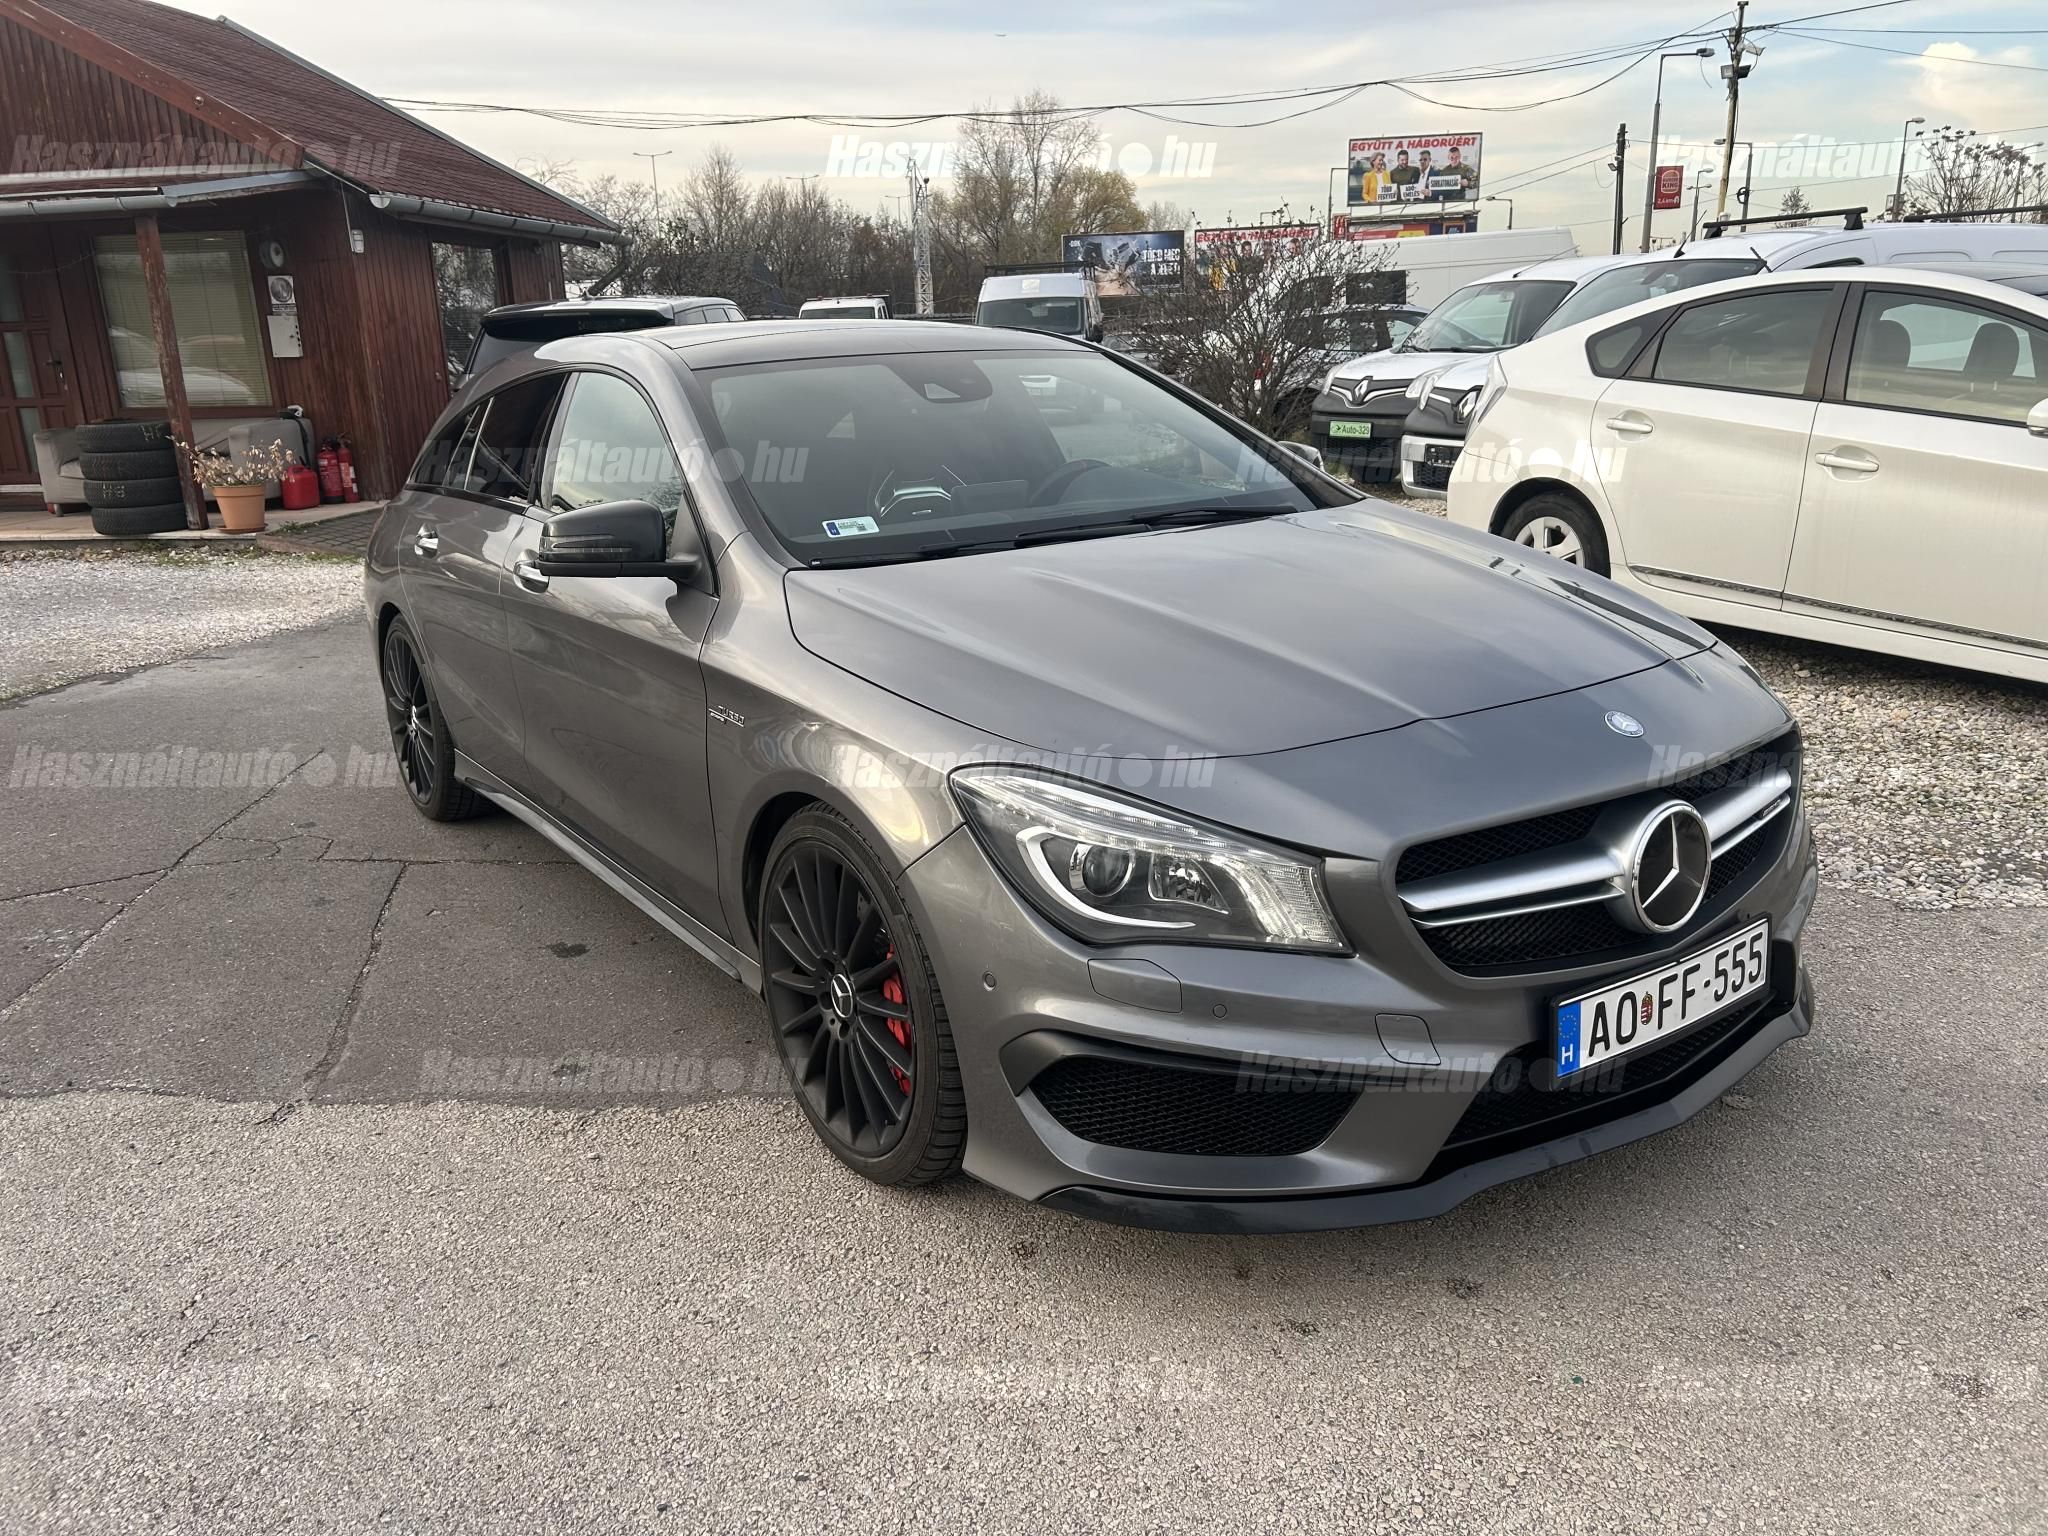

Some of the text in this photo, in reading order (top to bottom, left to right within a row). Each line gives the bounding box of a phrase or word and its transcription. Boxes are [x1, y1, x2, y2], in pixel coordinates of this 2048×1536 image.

[1351, 136, 1477, 151] EGYÜTT A HÁBORÚÉRT
[1561, 1044, 1574, 1065] H
